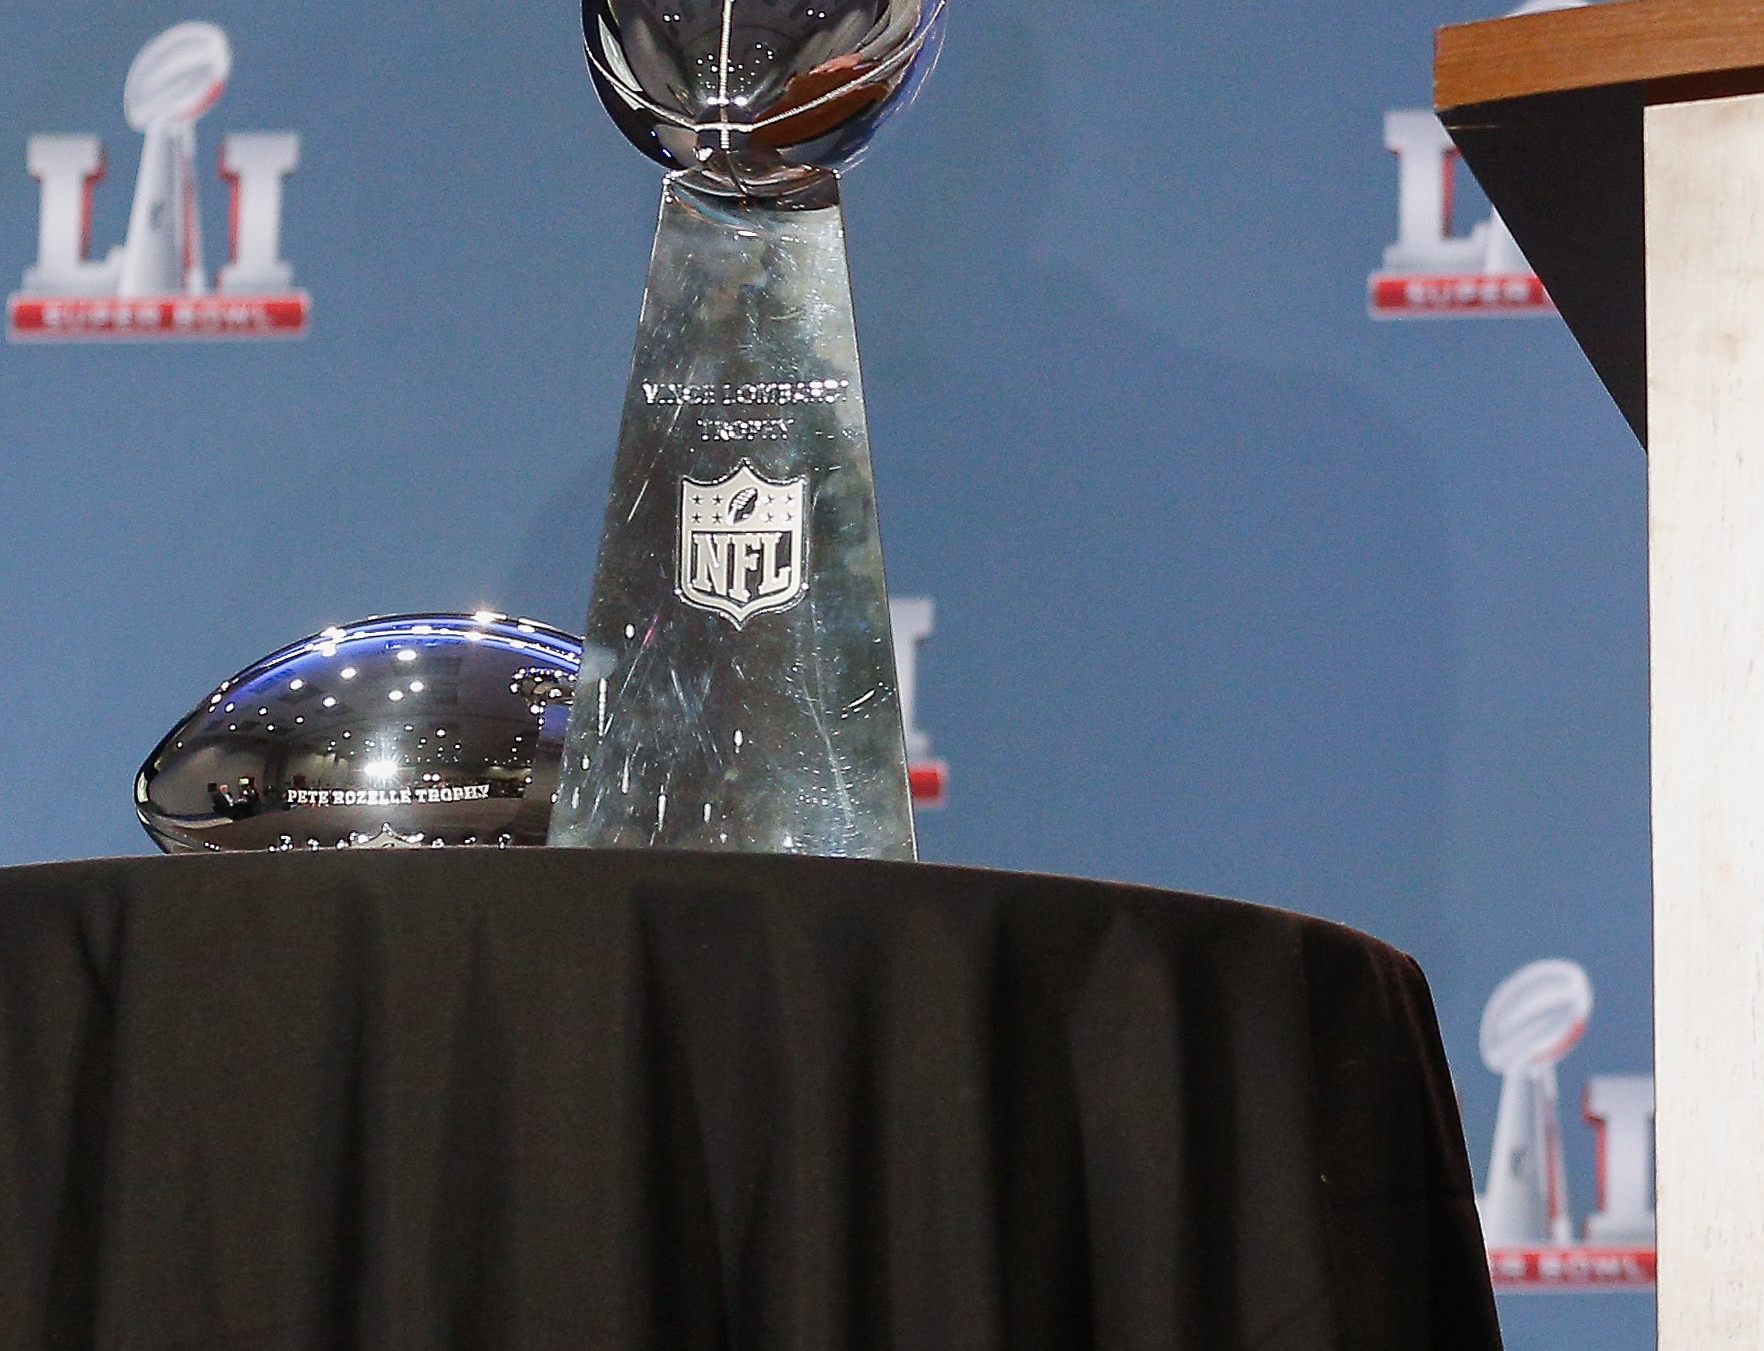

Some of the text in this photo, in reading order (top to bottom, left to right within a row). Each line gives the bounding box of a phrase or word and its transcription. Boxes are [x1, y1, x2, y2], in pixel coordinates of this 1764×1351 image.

[22, 131, 300, 298] LI
[1404, 280, 1531, 310] SUPER
[41, 299, 271, 332] SUPER BOWL
[690, 531, 793, 602] NFL
[286, 783, 491, 806] PETE ROZELLE TROPHY
[1537, 1251, 1640, 1286] BOWL
